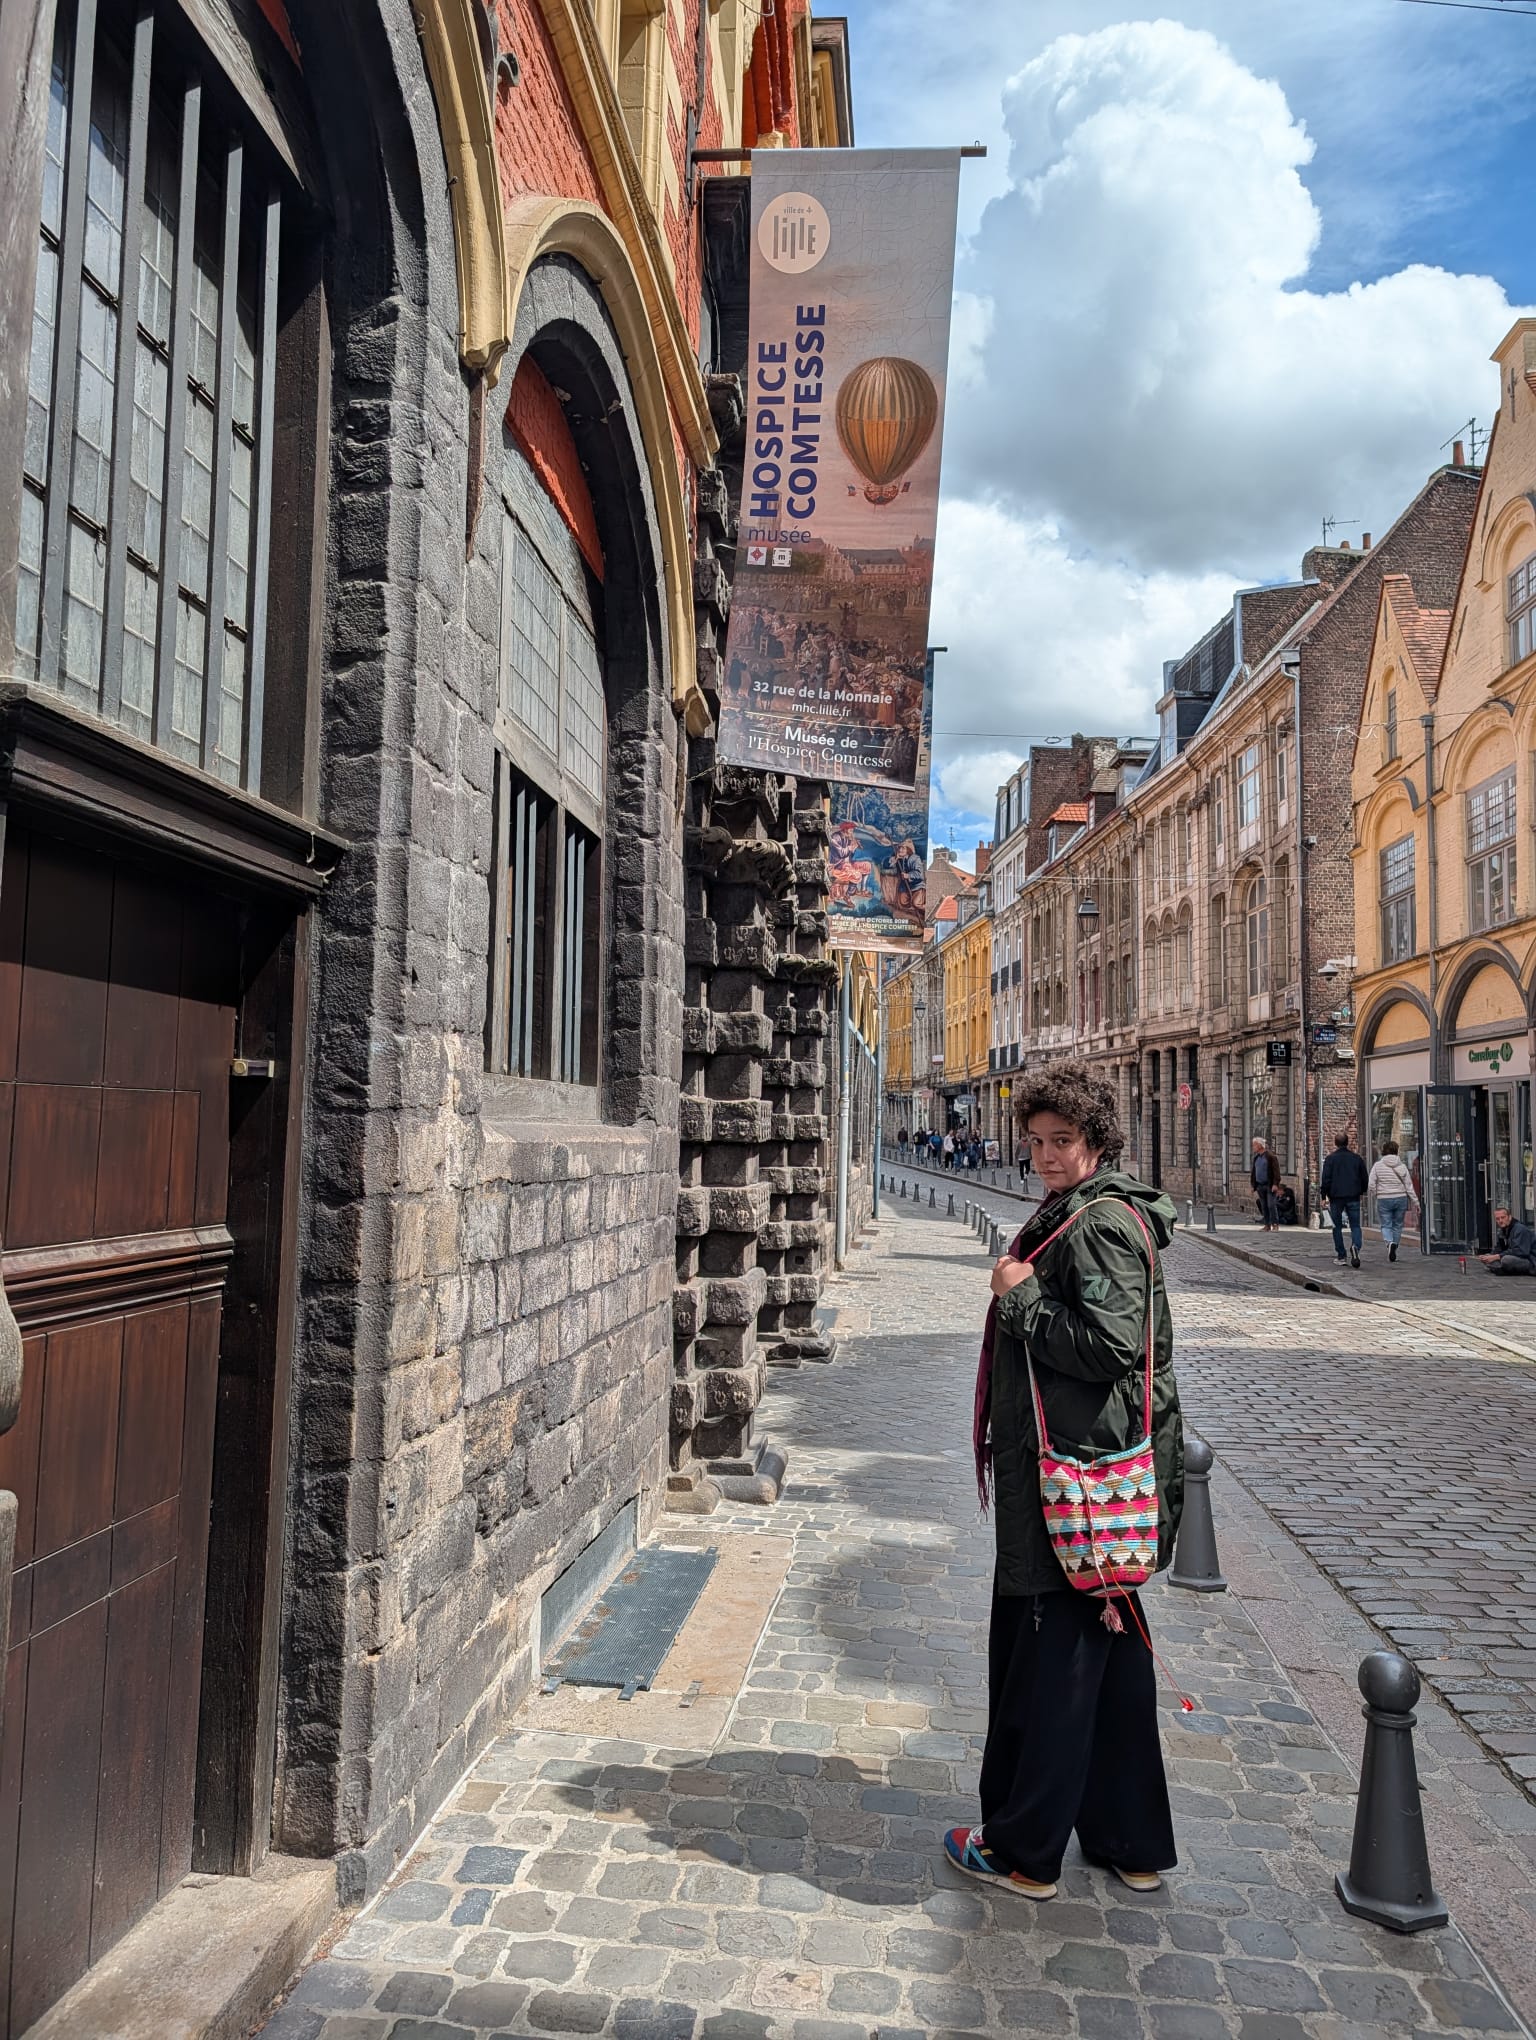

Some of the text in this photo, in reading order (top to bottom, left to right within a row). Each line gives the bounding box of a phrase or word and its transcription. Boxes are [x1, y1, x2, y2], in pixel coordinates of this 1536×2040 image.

[787, 304, 827, 520] COMTESSE
[749, 341, 788, 518] HOSPICE
[748, 525, 812, 544] musée
[753, 681, 893, 705] 32 rue de la Monnaie
[792, 703, 852, 718] mhc.lille.fr
[785, 725, 859, 749] Musée de
[748, 735, 893, 769] l'Hospice Comtesse
[1469, 1047, 1499, 1063] Carrefour
